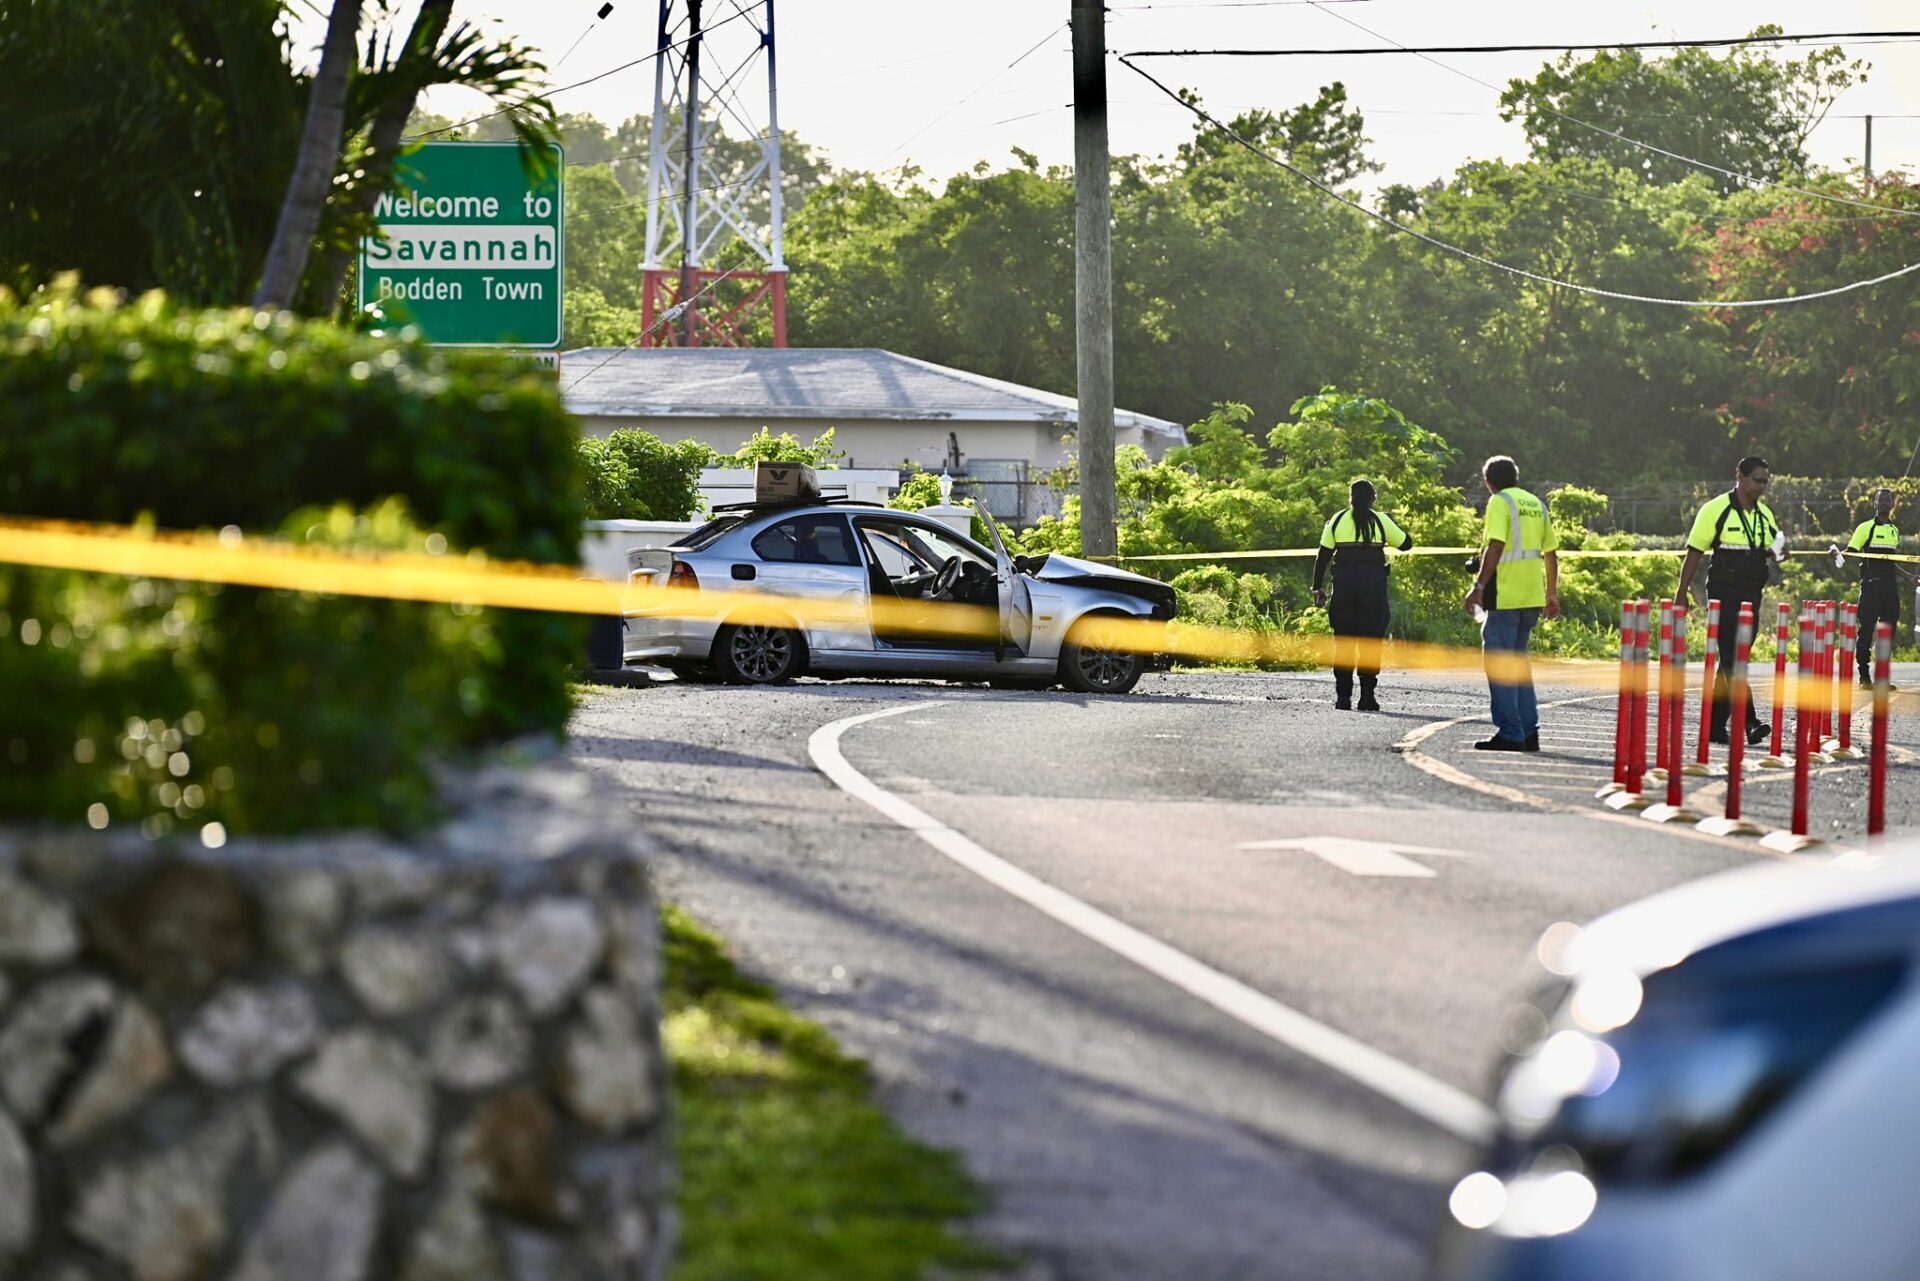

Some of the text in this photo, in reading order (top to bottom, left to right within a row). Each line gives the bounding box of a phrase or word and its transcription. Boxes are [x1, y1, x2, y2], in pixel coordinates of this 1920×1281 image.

[373, 190, 552, 218] Welcome to
[371, 233, 552, 261] Savannah
[379, 276, 543, 300] Bodden Town
